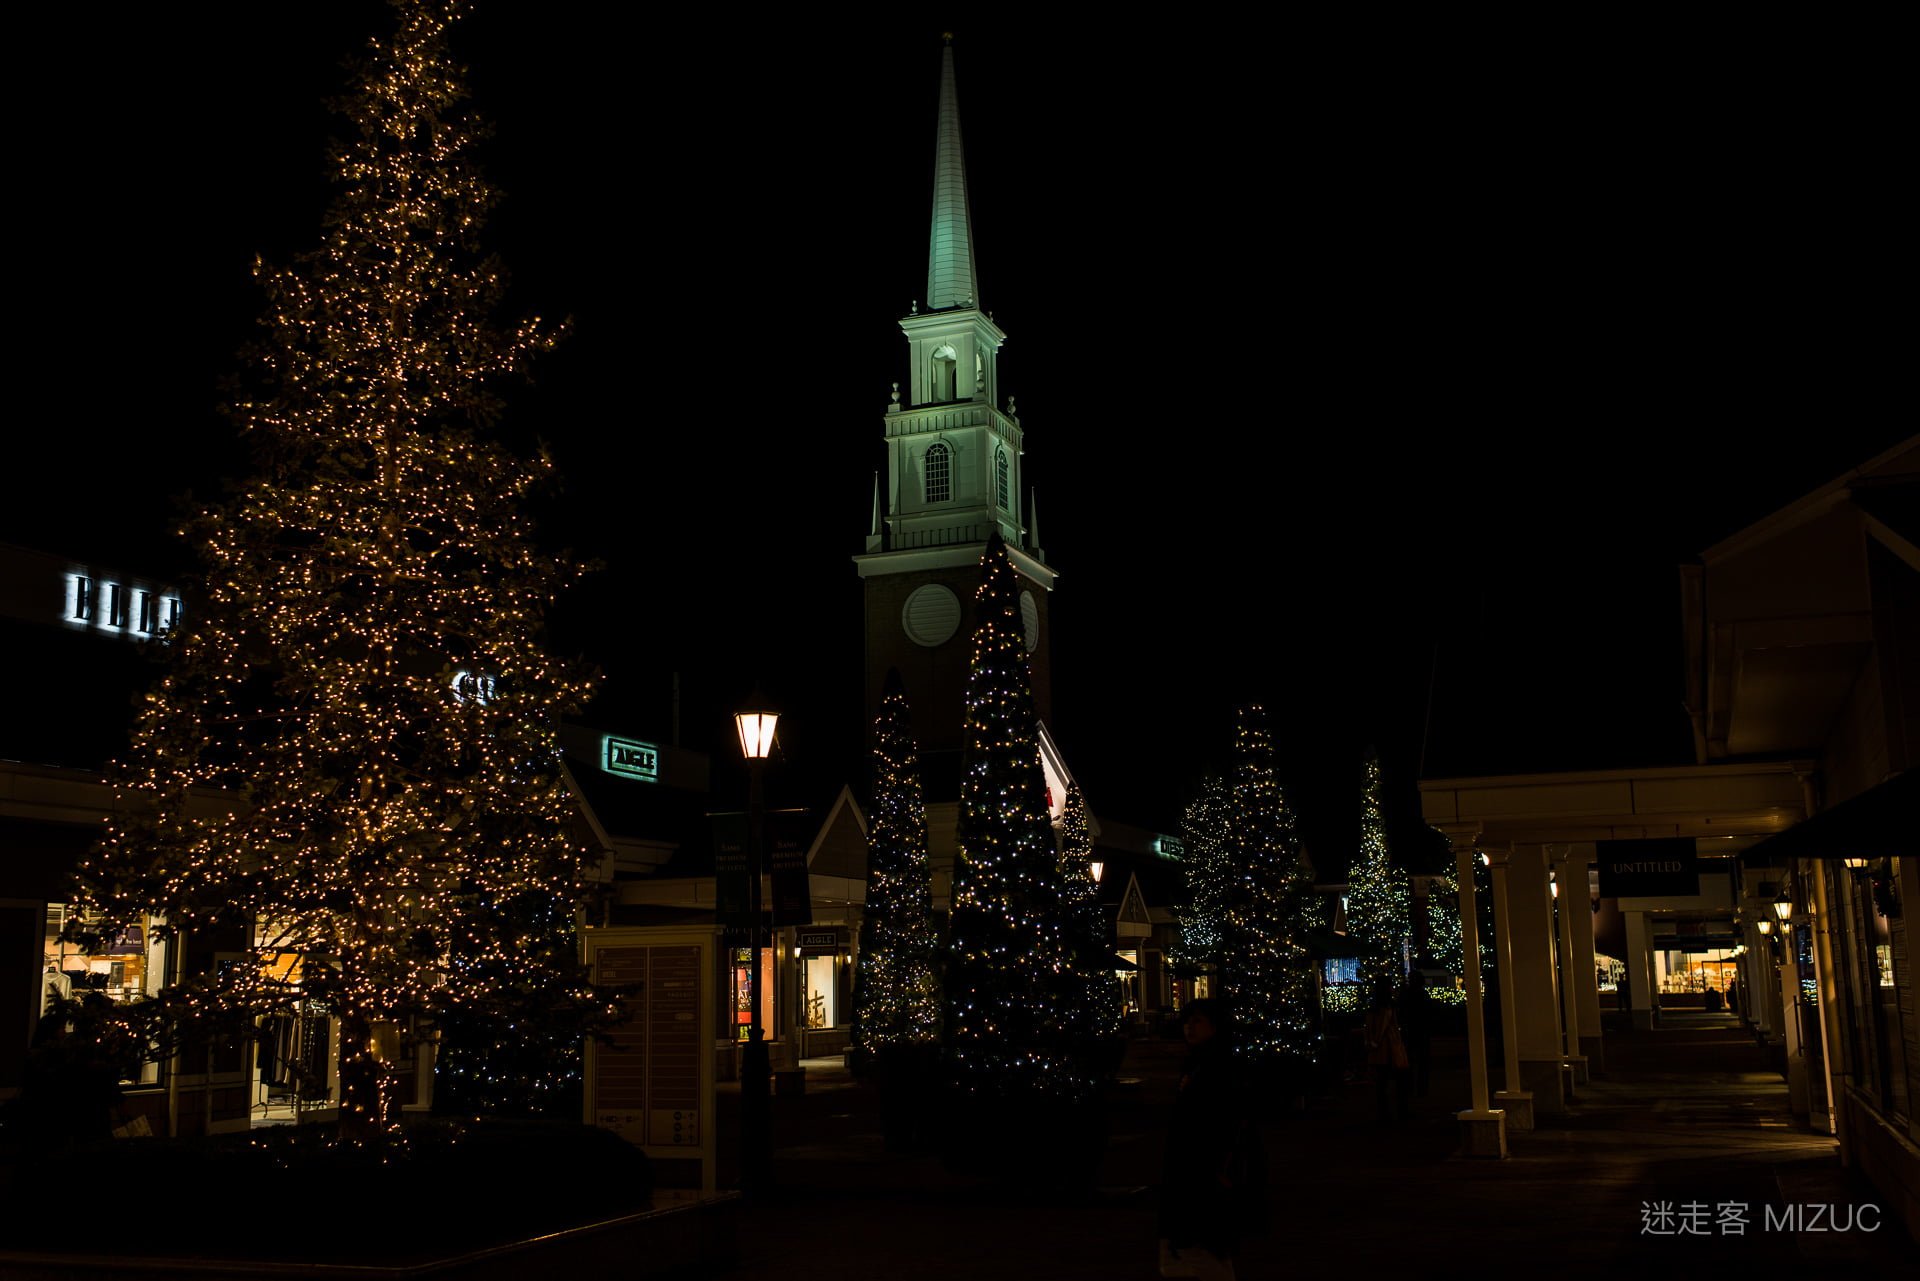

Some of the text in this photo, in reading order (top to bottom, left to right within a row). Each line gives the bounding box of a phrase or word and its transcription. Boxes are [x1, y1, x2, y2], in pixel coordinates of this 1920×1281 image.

[614, 746, 655, 769] AIGLE
[1613, 861, 1683, 875] UNTITLED
[805, 935, 833, 945] AIGLE
